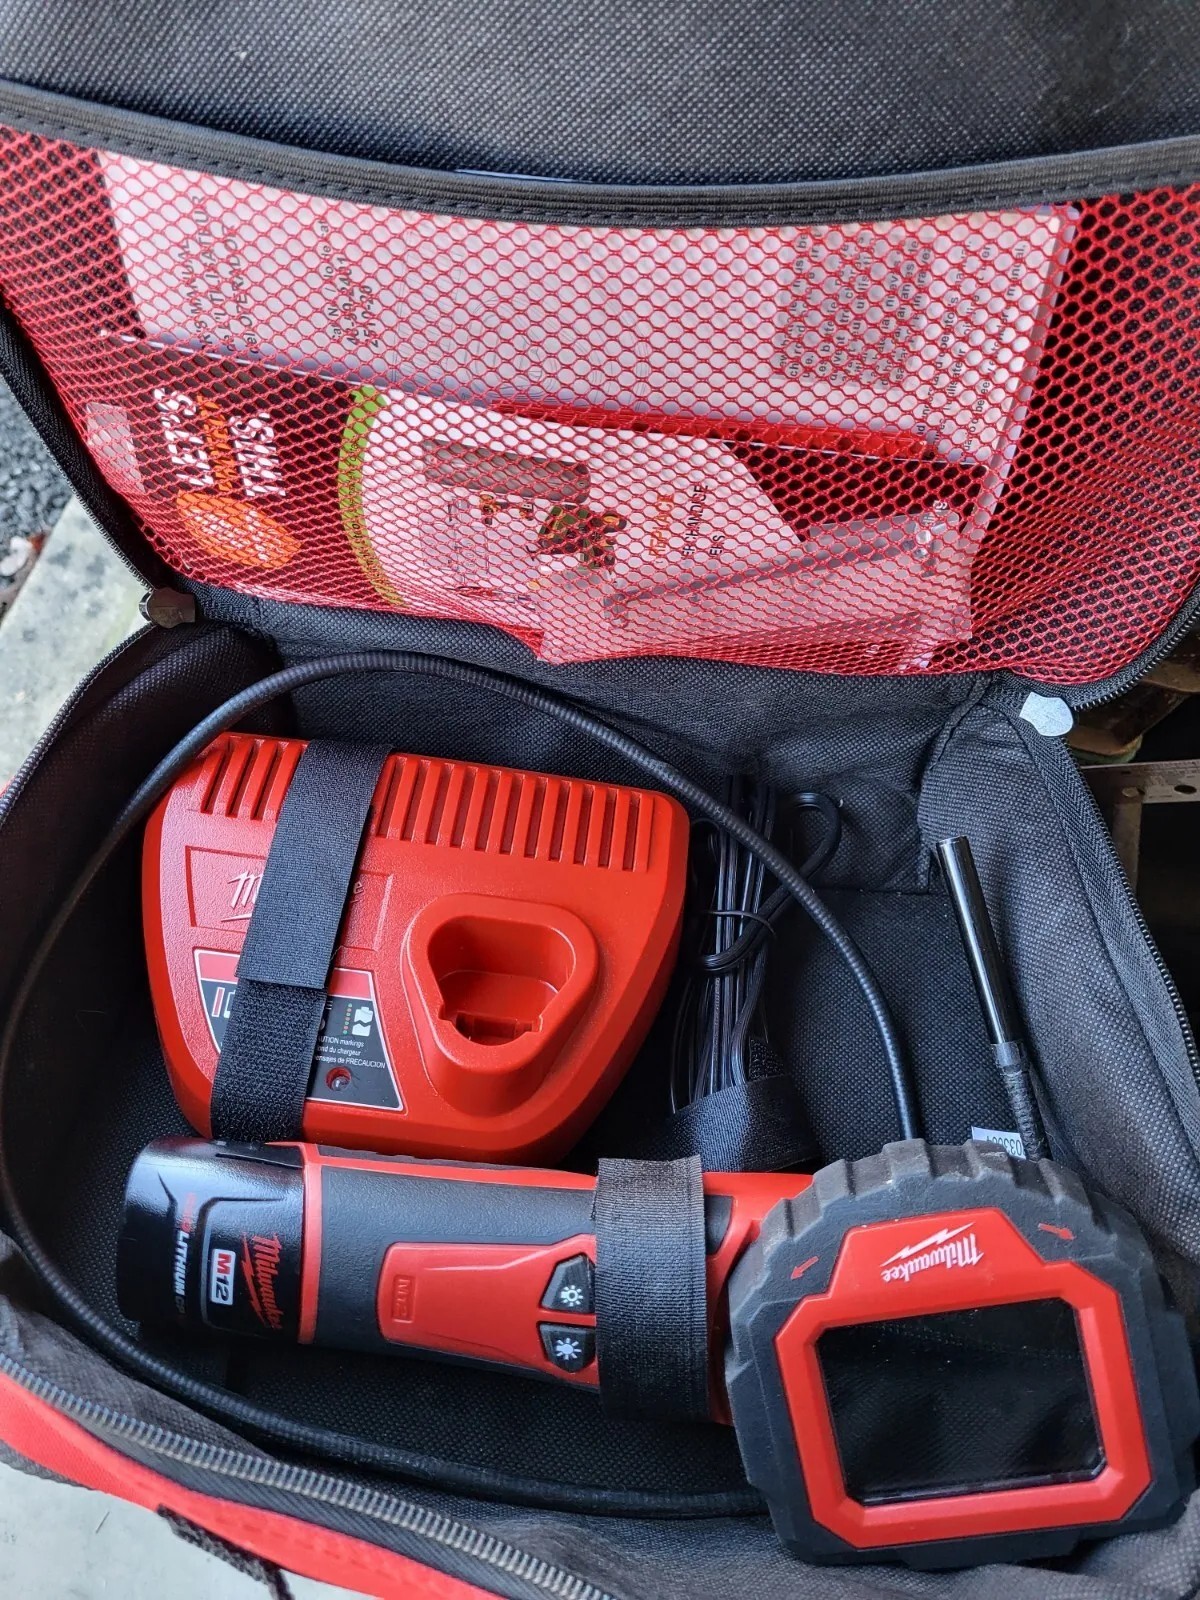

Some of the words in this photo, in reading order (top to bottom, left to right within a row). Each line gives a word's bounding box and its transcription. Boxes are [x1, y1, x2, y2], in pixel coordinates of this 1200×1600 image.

[153, 389, 214, 486] LET'S
[681, 485, 708, 559] ERCHANDISE
[215, 1252, 232, 1302] M12
[252, 1231, 285, 1330] Milwaukee
[880, 1232, 985, 1283] Milwaukee
[396, 1278, 411, 1318] M12
